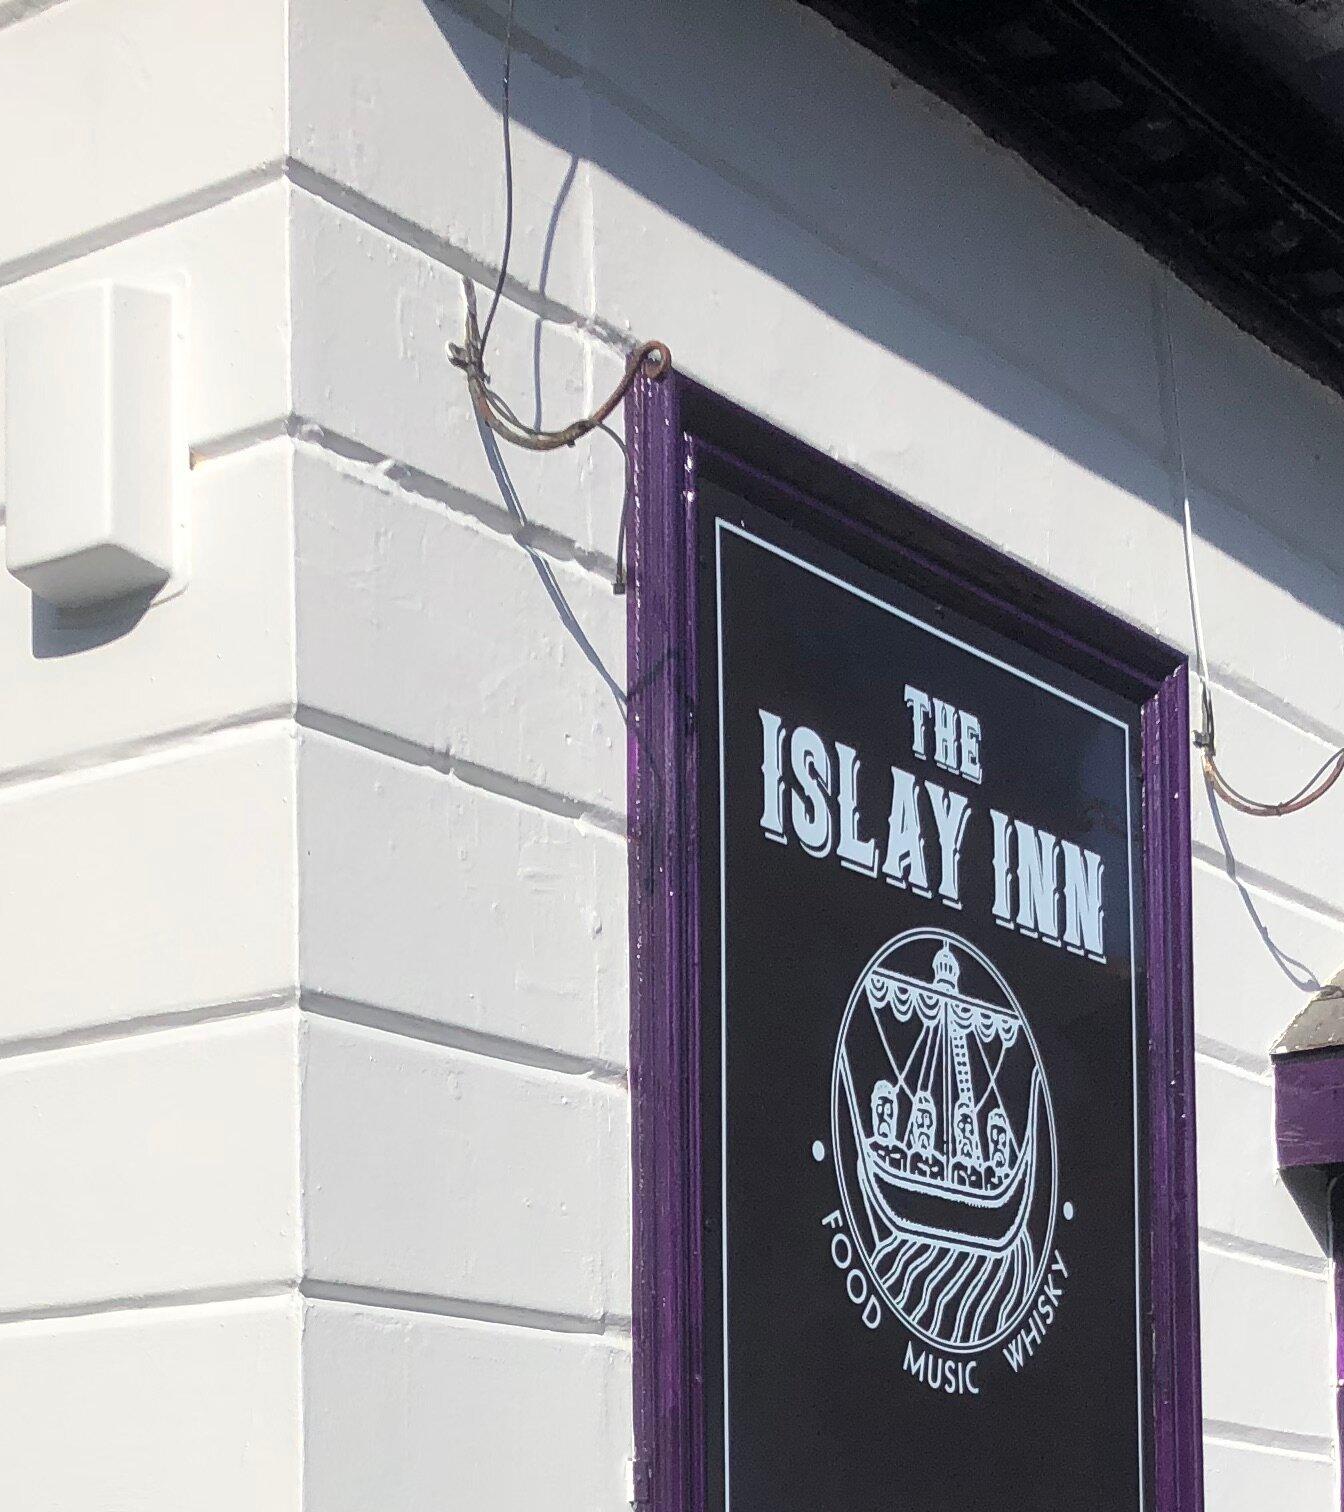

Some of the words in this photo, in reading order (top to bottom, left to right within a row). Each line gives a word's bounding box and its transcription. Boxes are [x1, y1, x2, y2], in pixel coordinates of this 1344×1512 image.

[904, 684, 982, 784] THE
[759, 709, 971, 910] ISLAY
[990, 809, 1106, 964] INN
[822, 1210, 881, 1328] FOOD
[903, 1341, 979, 1394] MUSIC
[1003, 1250, 1068, 1372] WHISKY
